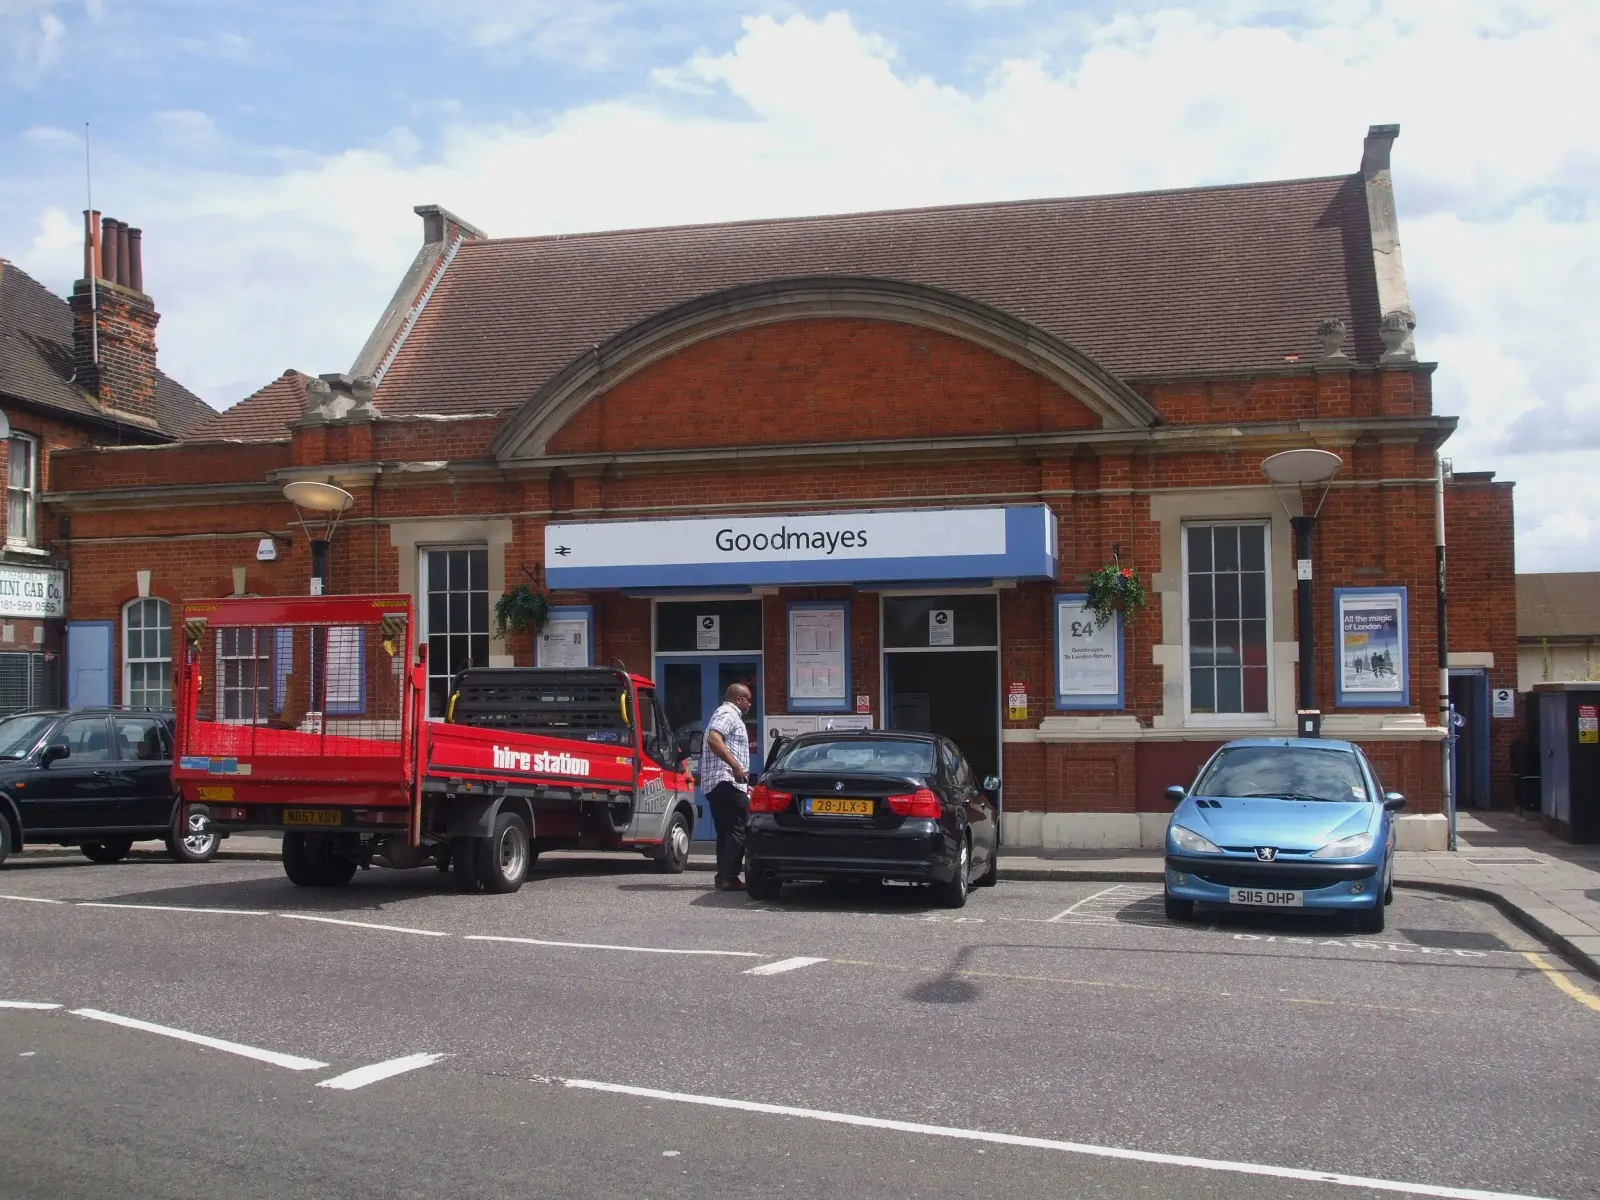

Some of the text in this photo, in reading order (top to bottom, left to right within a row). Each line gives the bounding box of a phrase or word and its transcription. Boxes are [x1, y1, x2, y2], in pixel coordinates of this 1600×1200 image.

[715, 525, 868, 555] Goodmayes
[24, 581, 44, 598] CAB
[1344, 623, 1382, 631] of London
[1369, 614, 1393, 623] magic
[1071, 621, 1094, 637] £4
[493, 745, 590, 776] hire station
[643, 772, 666, 797] tool
[644, 793, 667, 814] hire
[817, 800, 868, 813] 28-JLX-3
[1237, 890, 1295, 904] S115 OHP
[1233, 933, 1488, 958] DISABLED
